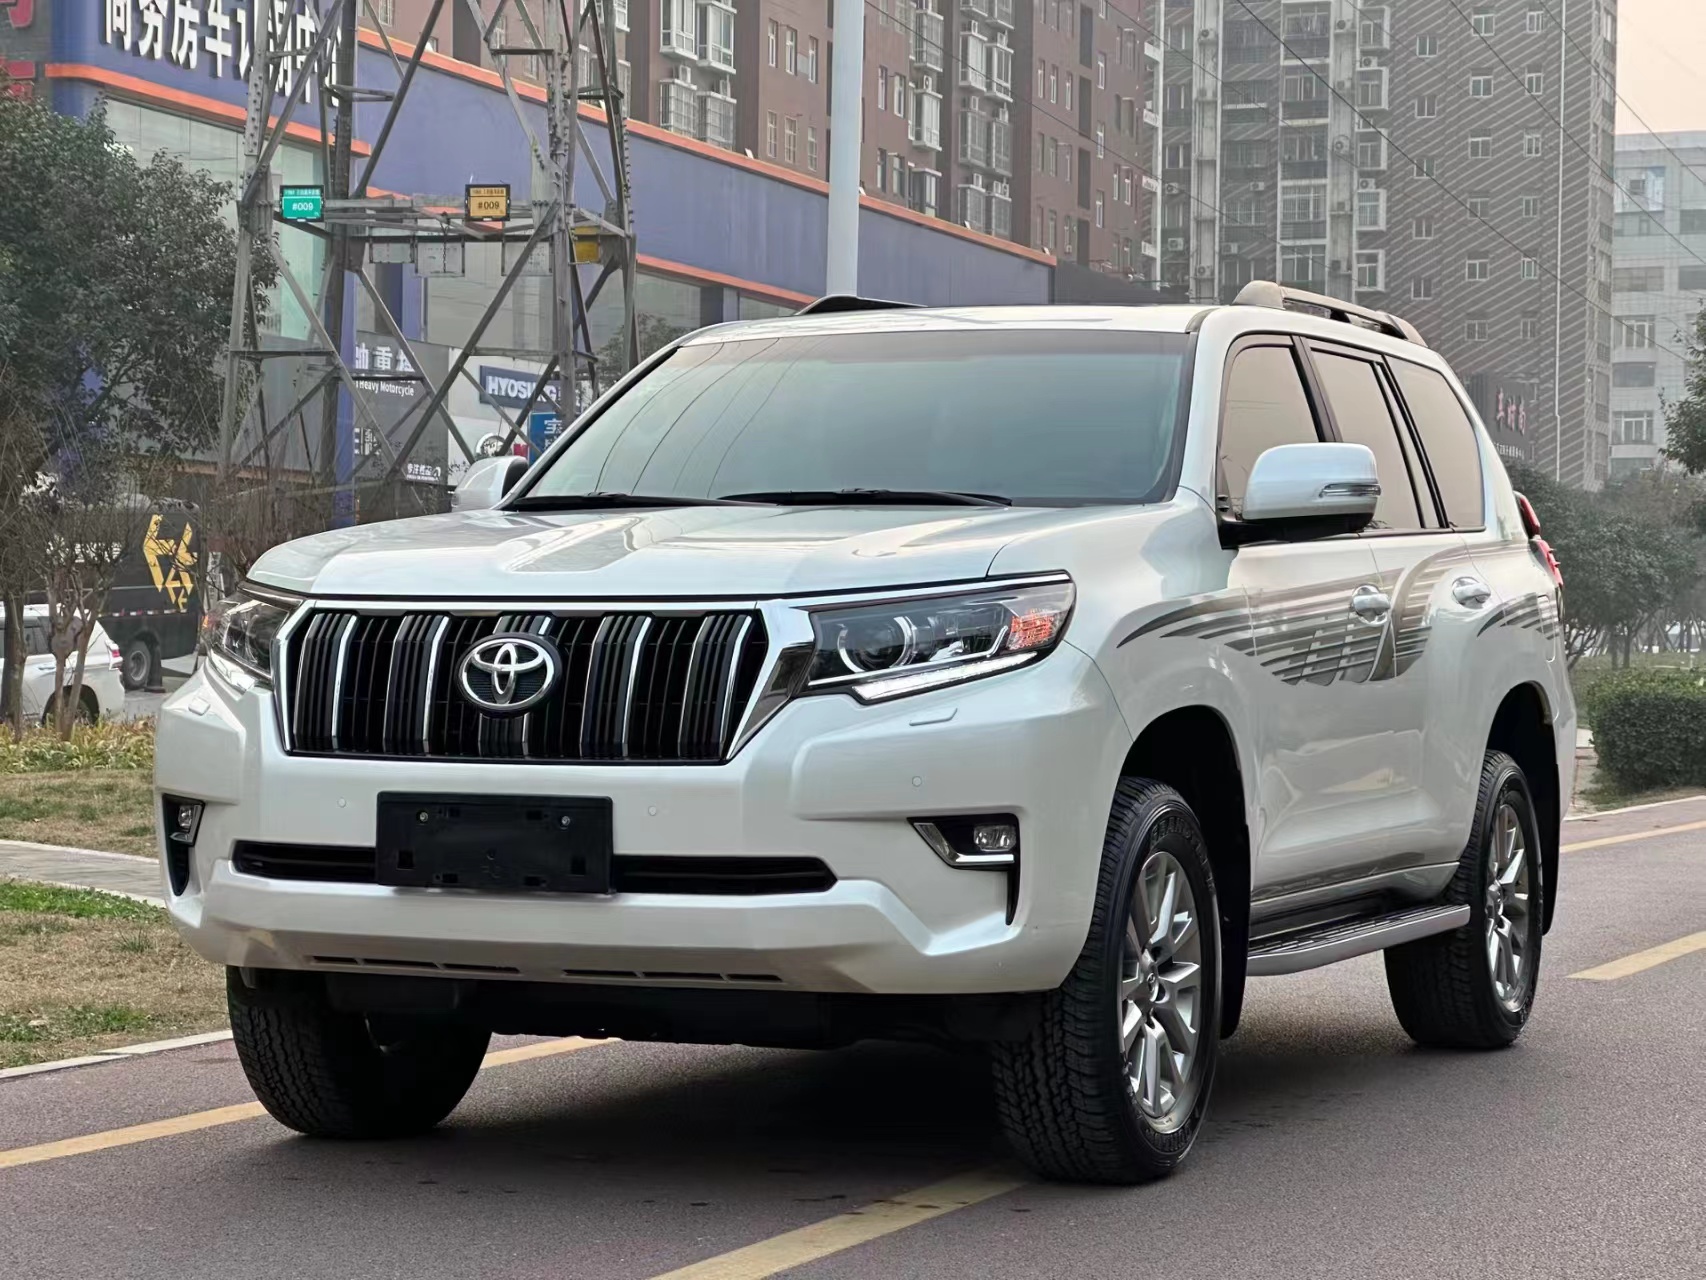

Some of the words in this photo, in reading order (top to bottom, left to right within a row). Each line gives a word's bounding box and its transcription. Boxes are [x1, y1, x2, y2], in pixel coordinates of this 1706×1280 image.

[292, 202, 314, 212] #009
[478, 201, 500, 210] #009
[359, 380, 379, 394] Heavy
[380, 380, 415, 397] Motorcycle
